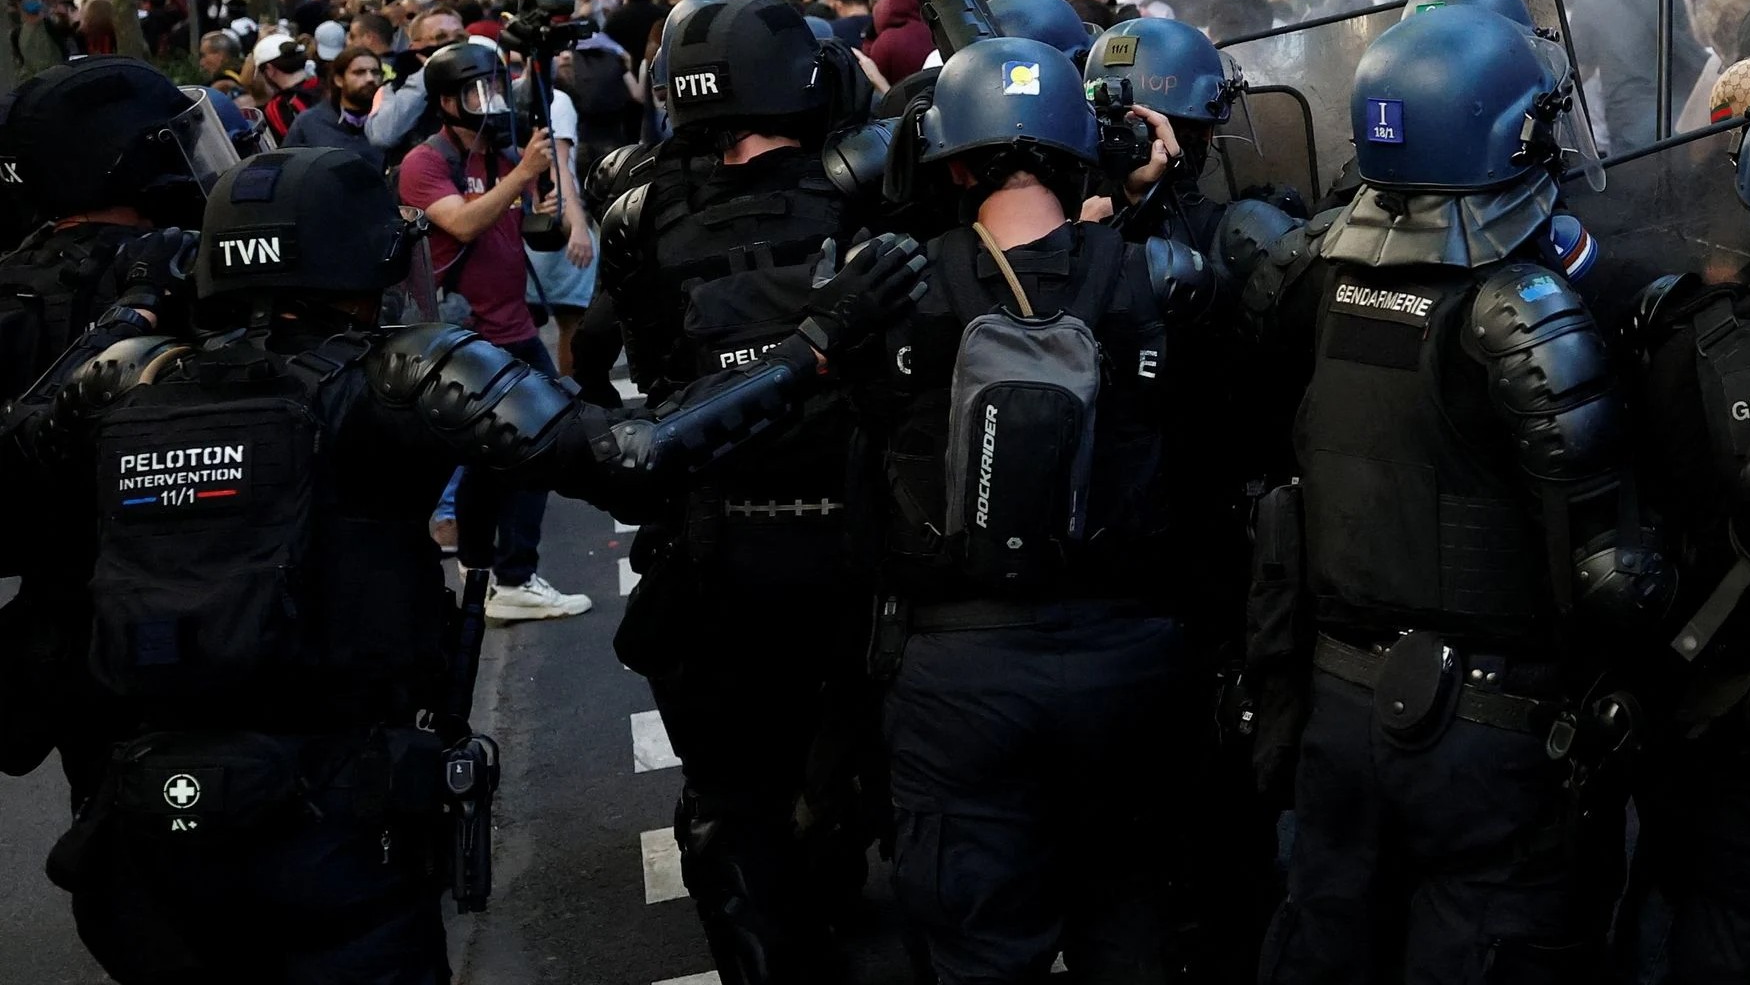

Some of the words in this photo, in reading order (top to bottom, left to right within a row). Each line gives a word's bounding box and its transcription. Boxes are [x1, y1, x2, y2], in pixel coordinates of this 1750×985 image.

[1111, 44, 1128, 54] 11/1
[675, 72, 719, 98] PTR
[1378, 102, 1388, 125] I
[1374, 127, 1395, 139] 18/1
[219, 237, 281, 266] TVN
[1336, 284, 1433, 317] GENDARMERIE
[120, 445, 244, 474] PELOTON
[976, 404, 998, 528] ROCKRIDER
[119, 468, 242, 491] INTERVENTION
[160, 486, 195, 506] 11/1
[171, 818, 198, 831] A+
